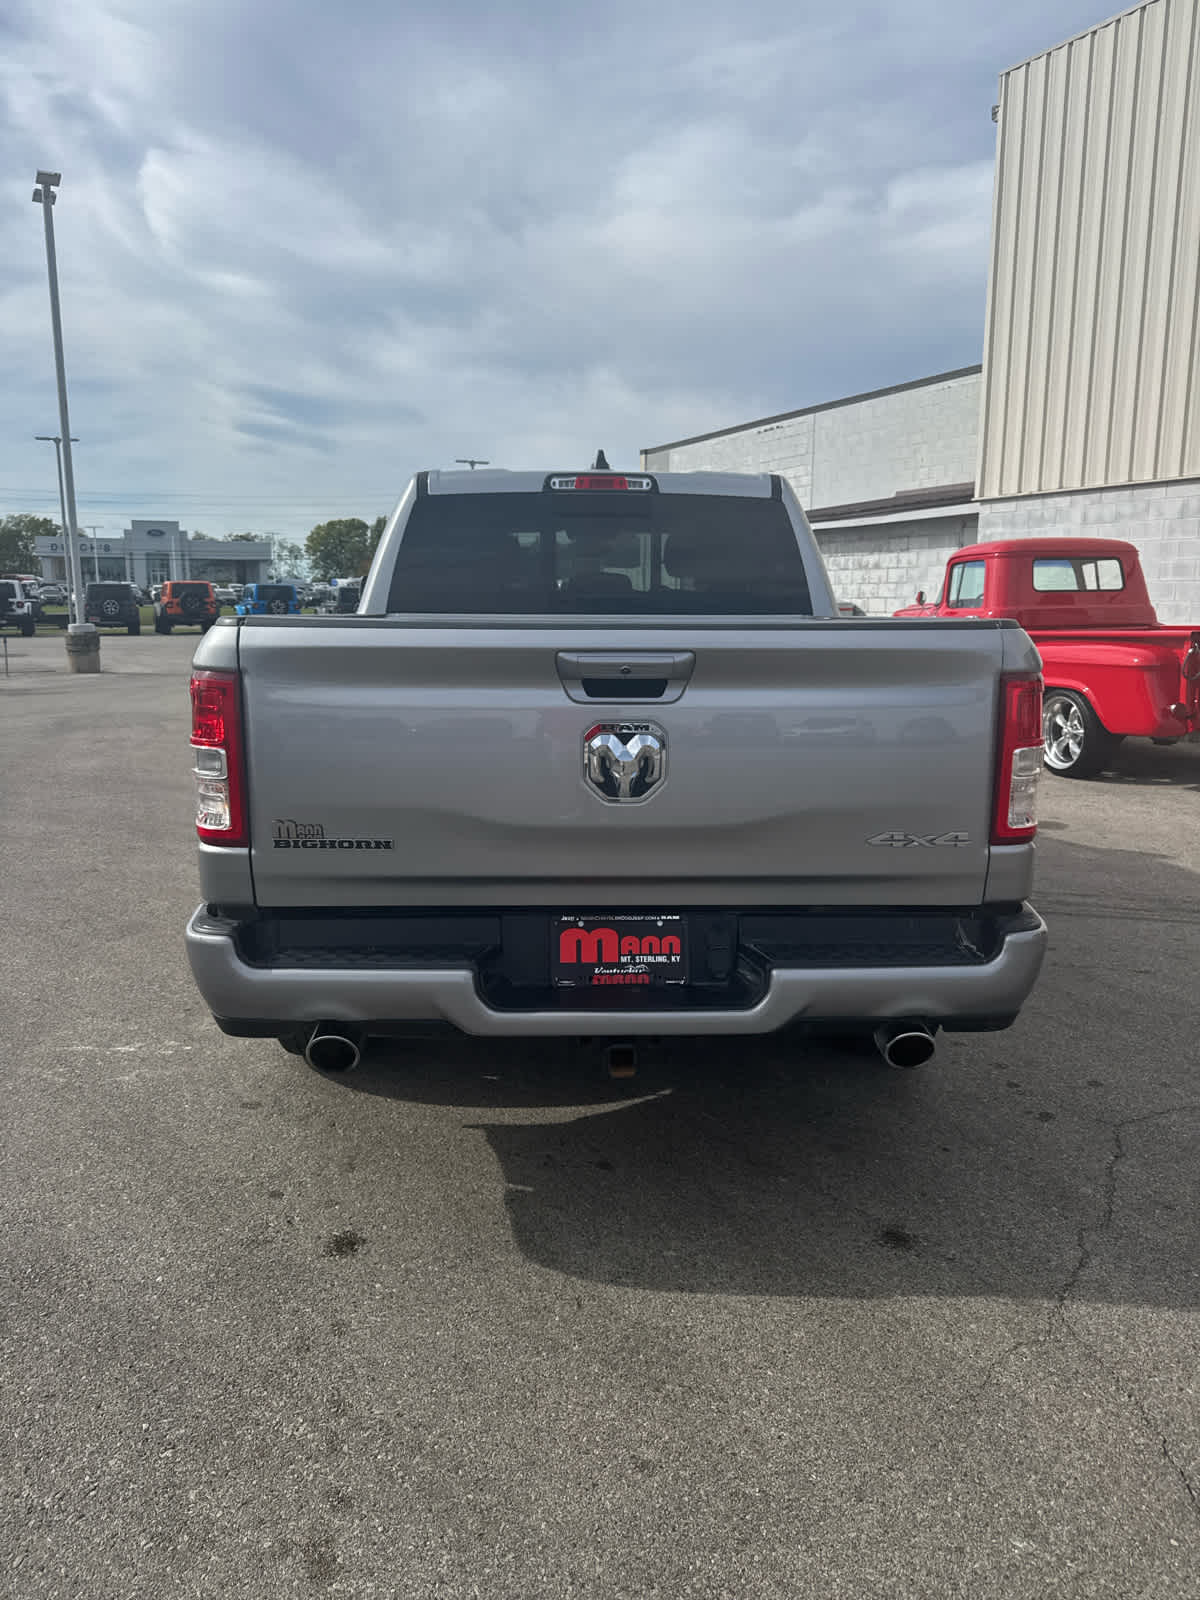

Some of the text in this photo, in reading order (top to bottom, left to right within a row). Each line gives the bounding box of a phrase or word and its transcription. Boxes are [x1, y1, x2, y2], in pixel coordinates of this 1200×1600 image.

[273, 839, 393, 849] BIGHORN
[620, 955, 681, 964] MT. STERLING, KY
